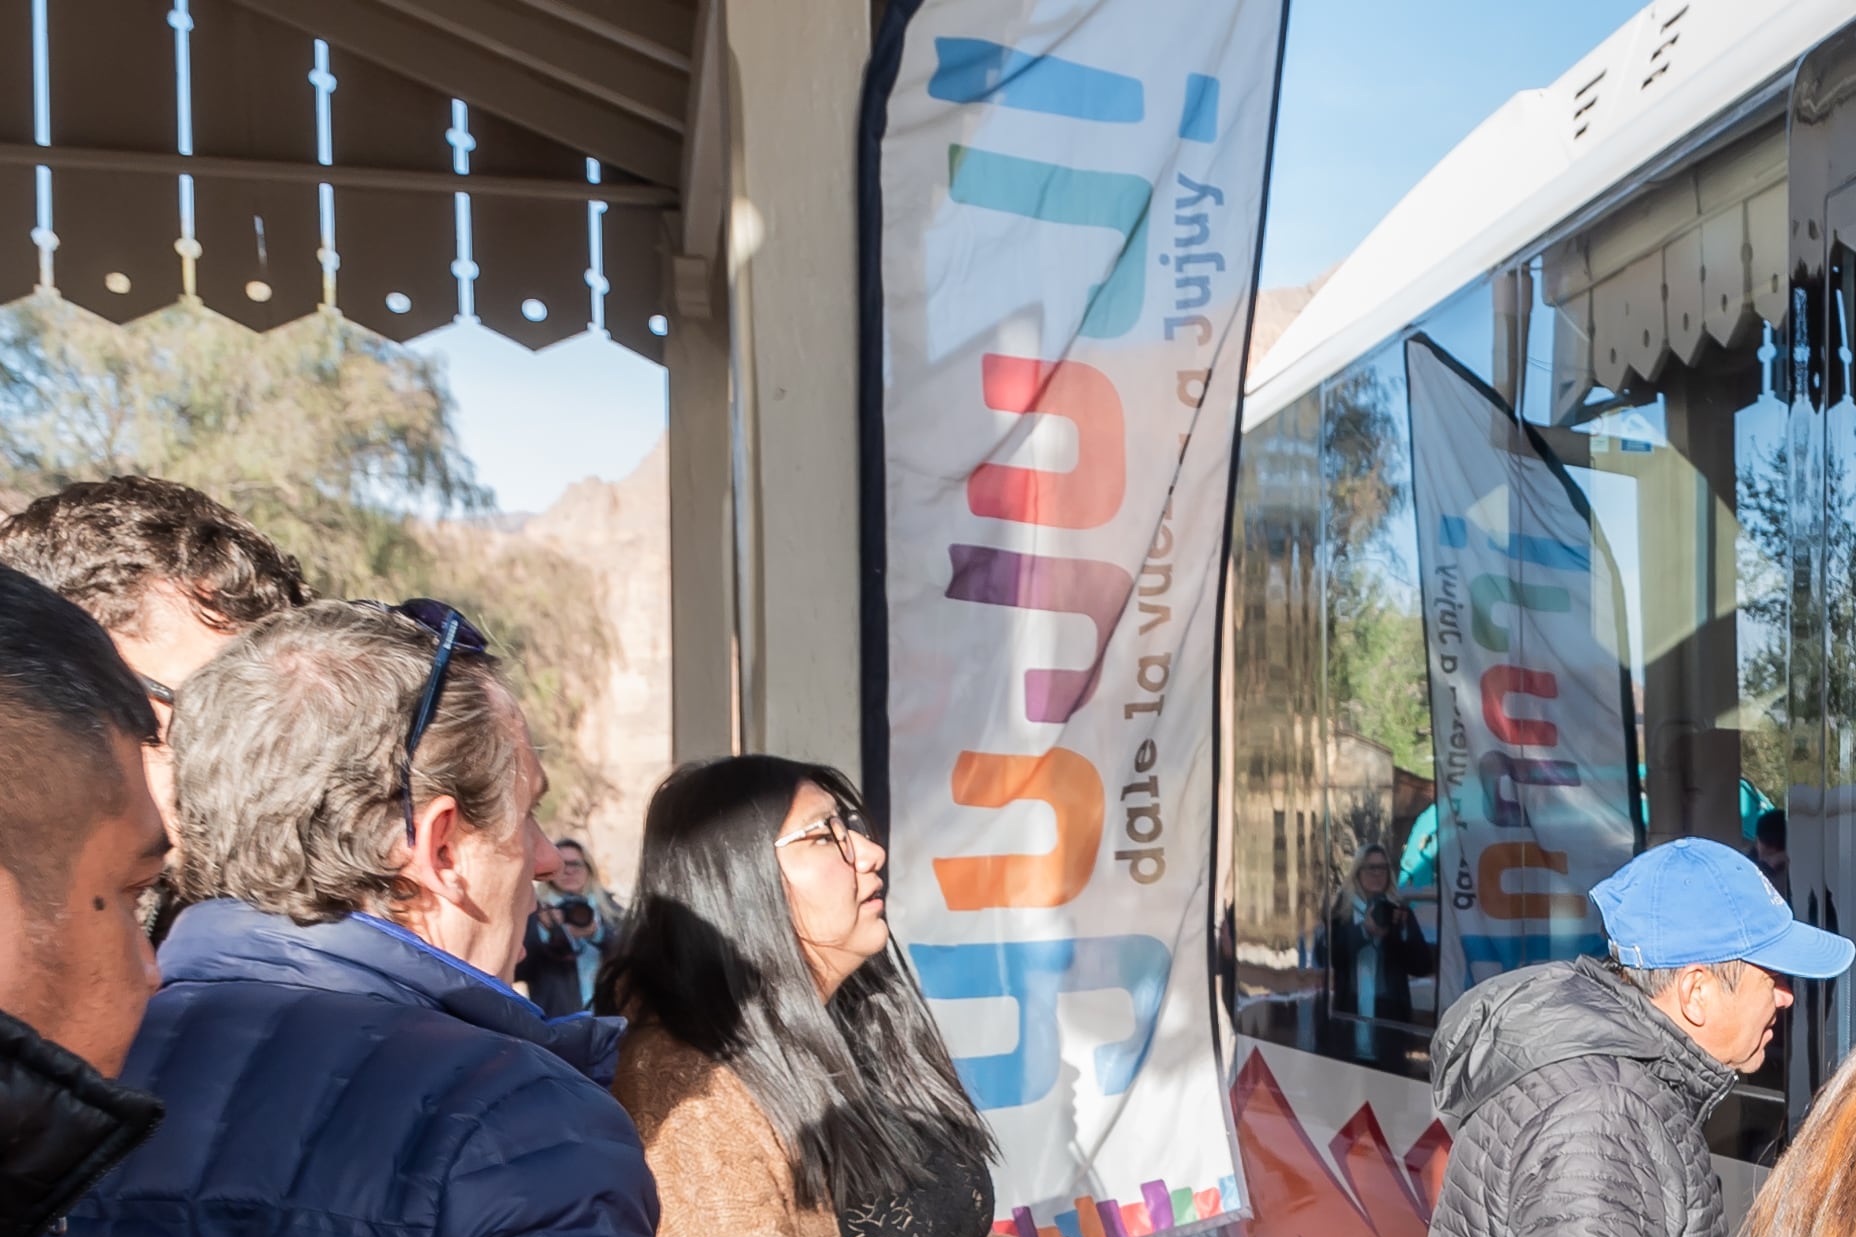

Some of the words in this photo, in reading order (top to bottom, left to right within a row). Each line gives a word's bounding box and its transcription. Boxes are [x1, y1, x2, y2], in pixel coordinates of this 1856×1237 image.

[1160, 173, 1225, 348] Jujuy
[1175, 368, 1212, 410] a
[1138, 433, 1191, 636] vue
[1124, 652, 1171, 720] la
[1115, 738, 1166, 885] dale
